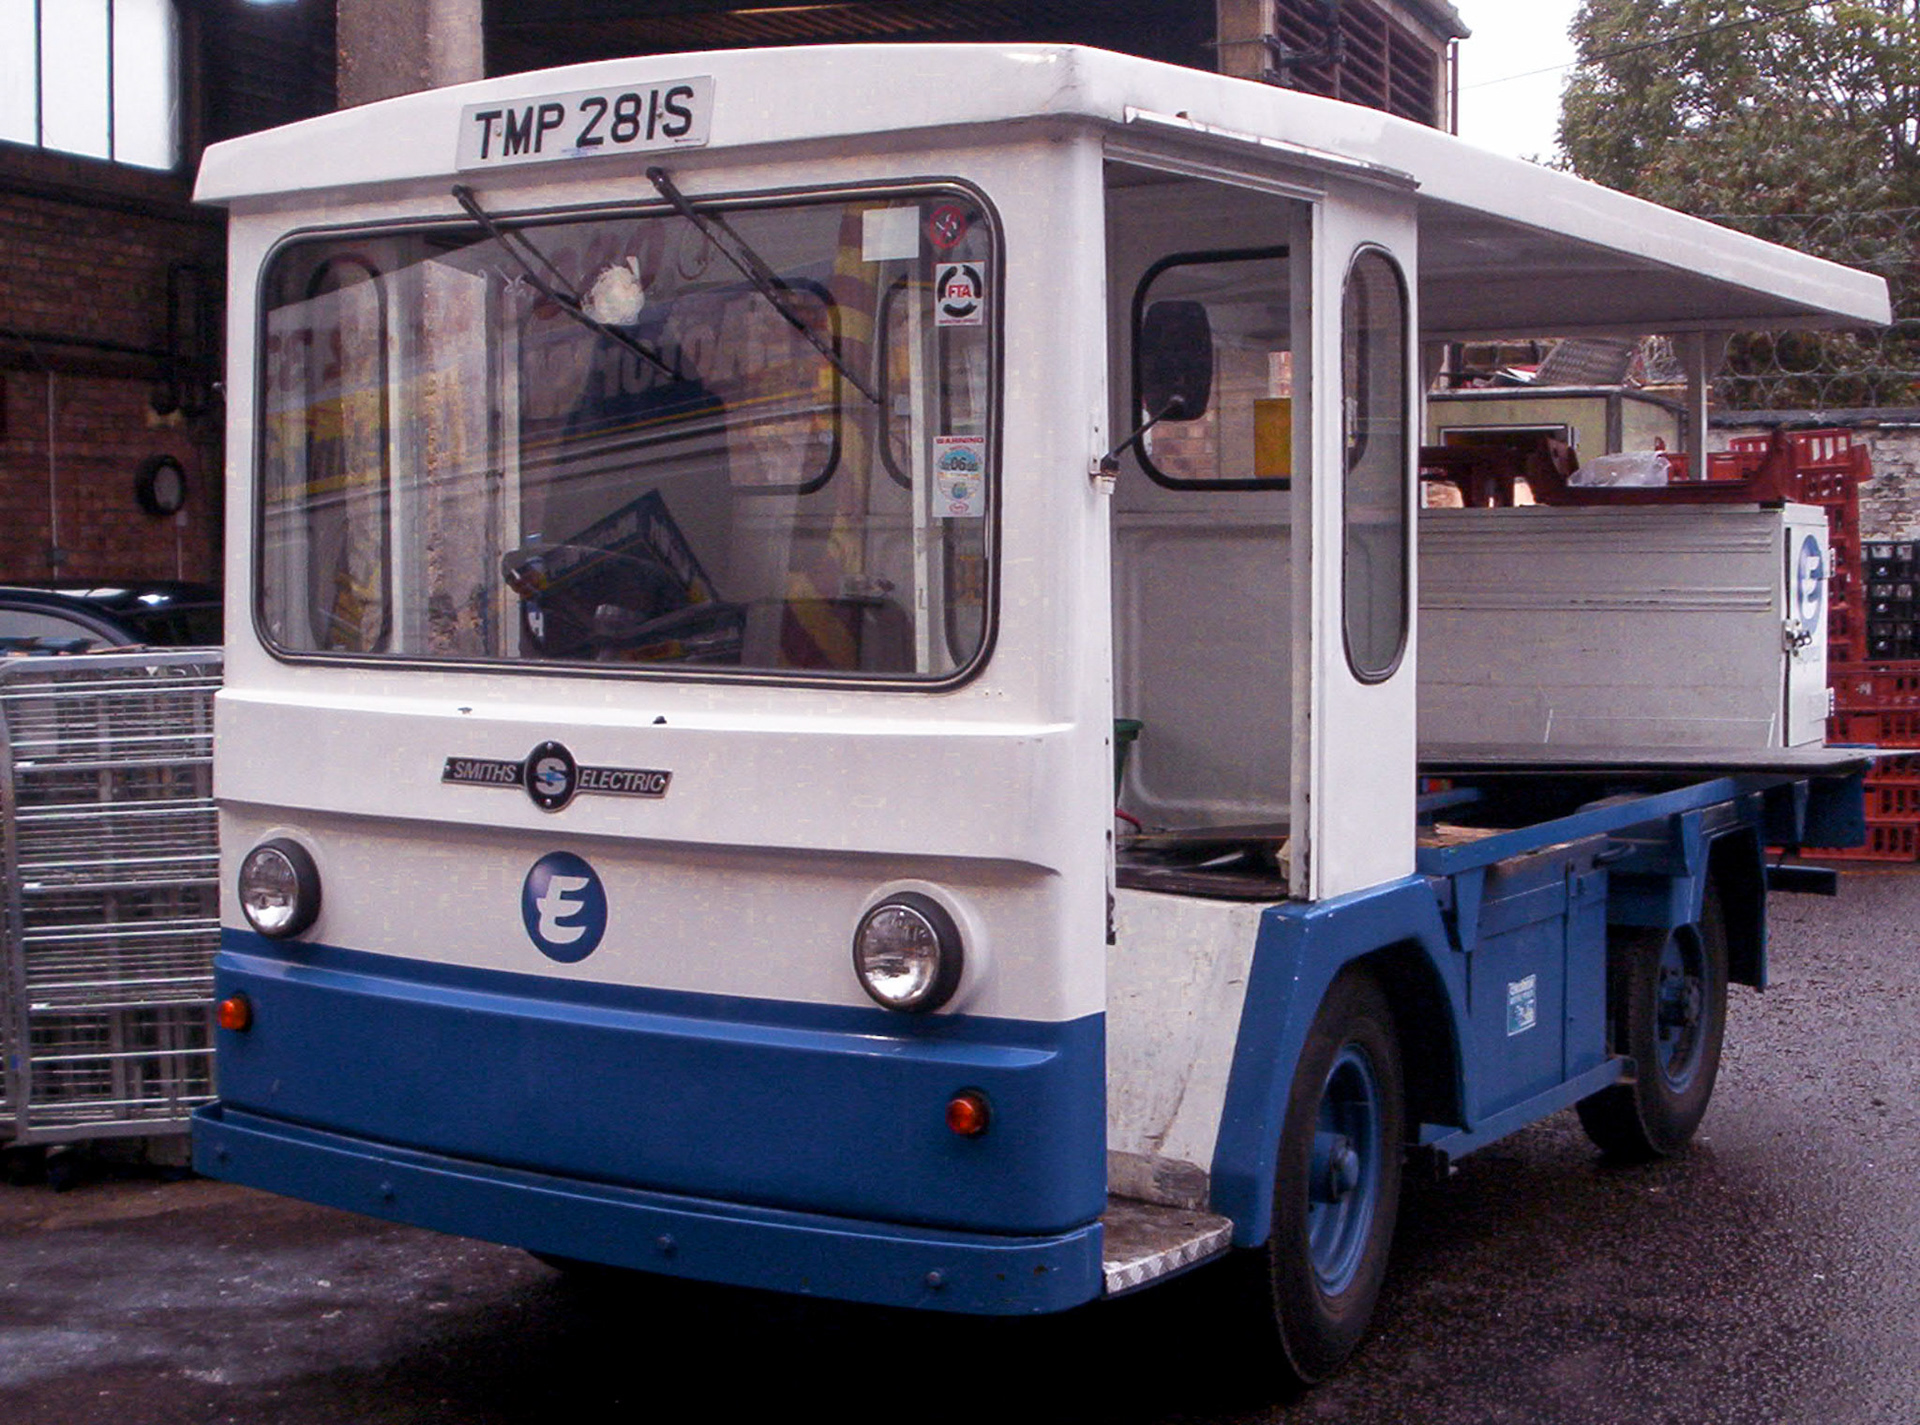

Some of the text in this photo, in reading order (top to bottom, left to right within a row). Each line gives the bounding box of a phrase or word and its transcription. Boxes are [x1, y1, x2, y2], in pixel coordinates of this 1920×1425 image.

[475, 85, 694, 159] TMP 281S
[948, 284, 972, 298] FTA
[453, 761, 517, 783] SMITHS
[579, 770, 666, 792] ELECTRIC
